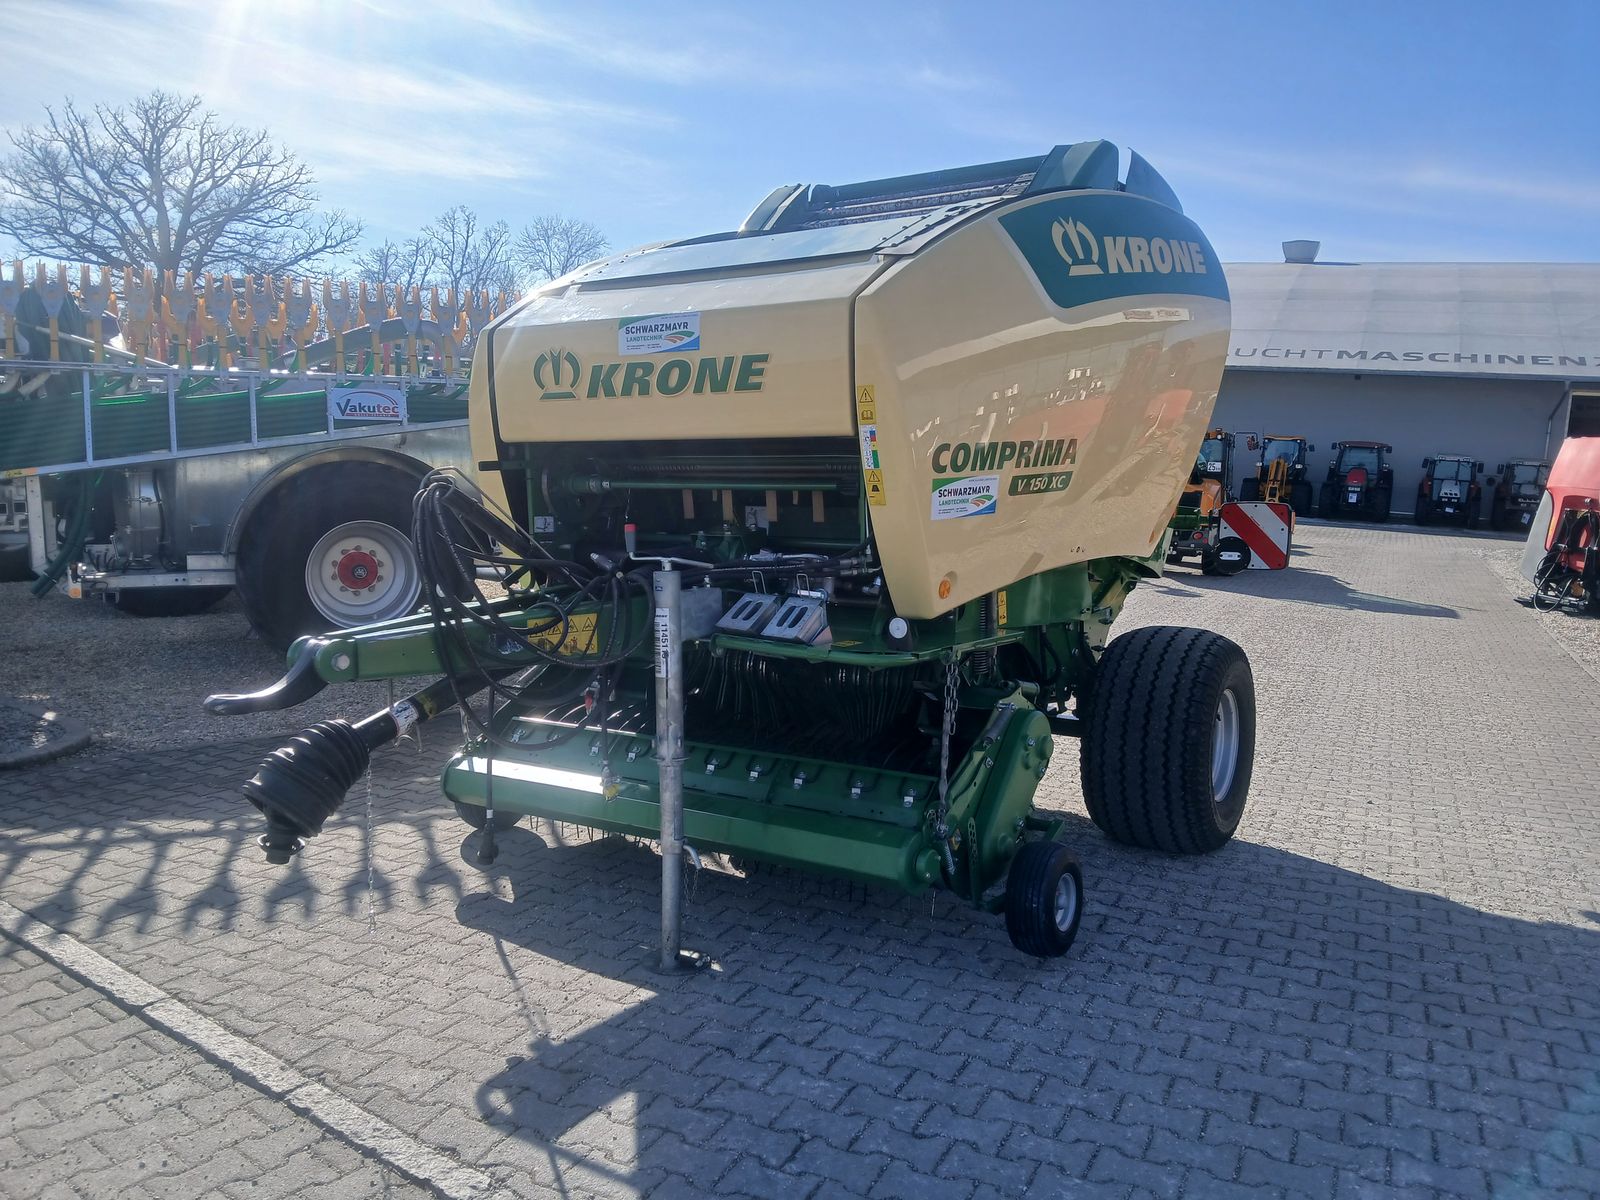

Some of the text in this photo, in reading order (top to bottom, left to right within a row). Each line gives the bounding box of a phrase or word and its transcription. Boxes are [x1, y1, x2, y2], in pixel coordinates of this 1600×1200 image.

[1103, 236, 1207, 275] KRONE
[625, 321, 689, 335] SCHWARZMAYR
[626, 334, 663, 343] LANDTECHNIK
[1227, 347, 1600, 367] UCHTMASCHINEN
[586, 353, 770, 399] KRONE
[336, 398, 399, 416] Vakutec
[931, 438, 1078, 474] COMPRIMA
[938, 485, 991, 498] SCHWARZMAYR
[1017, 475, 1067, 492] V 150 XC
[939, 498, 970, 506] LANDTECHNIK
